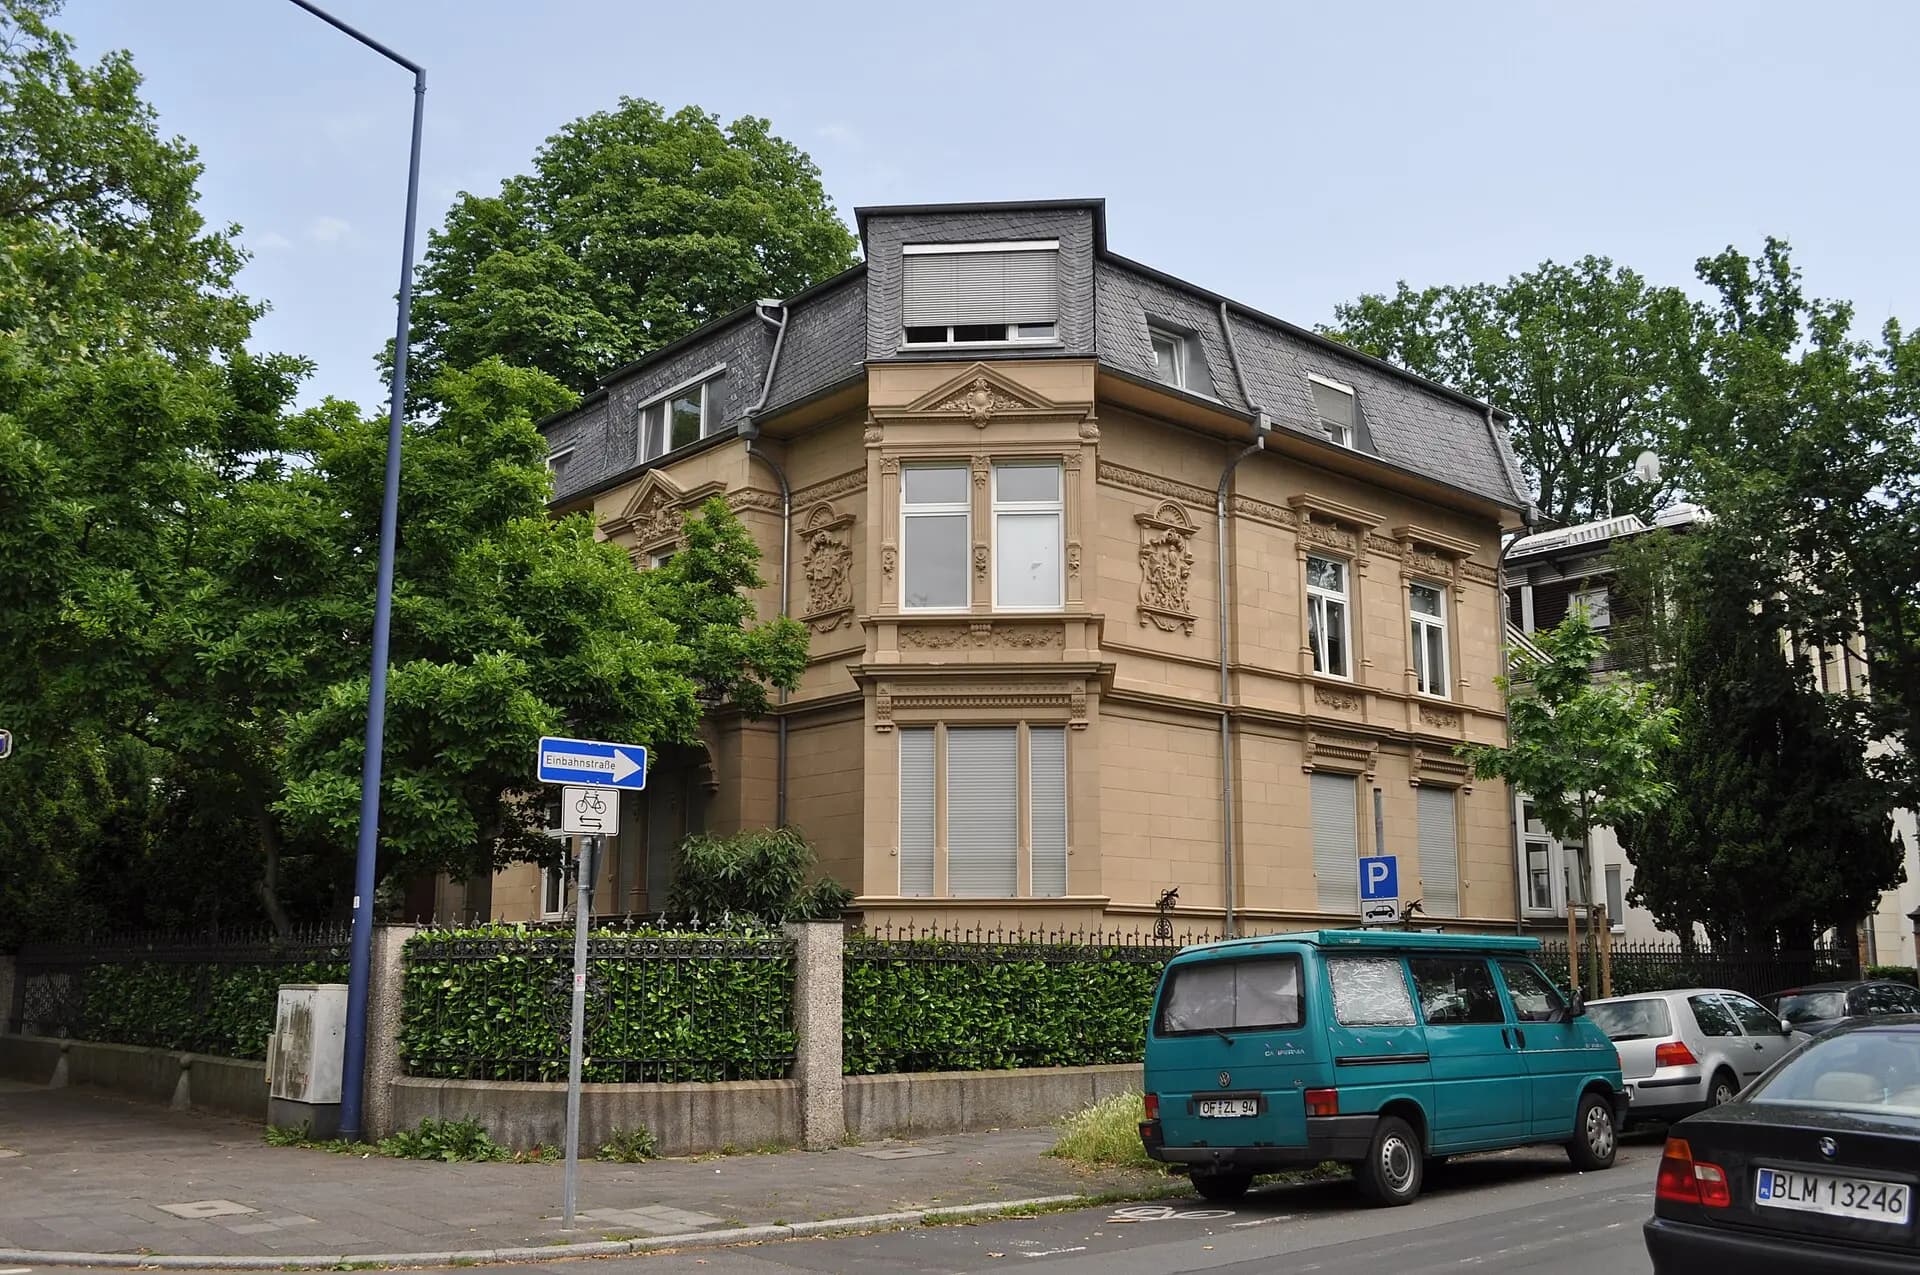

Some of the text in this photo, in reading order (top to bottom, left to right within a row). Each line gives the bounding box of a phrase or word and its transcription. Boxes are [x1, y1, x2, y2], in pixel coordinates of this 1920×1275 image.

[546, 755, 616, 770] Einbahnstraße
[1368, 862, 1389, 894] P
[1202, 1101, 1254, 1113] OF ZL 94
[1773, 1174, 1904, 1213] BLM 13246
